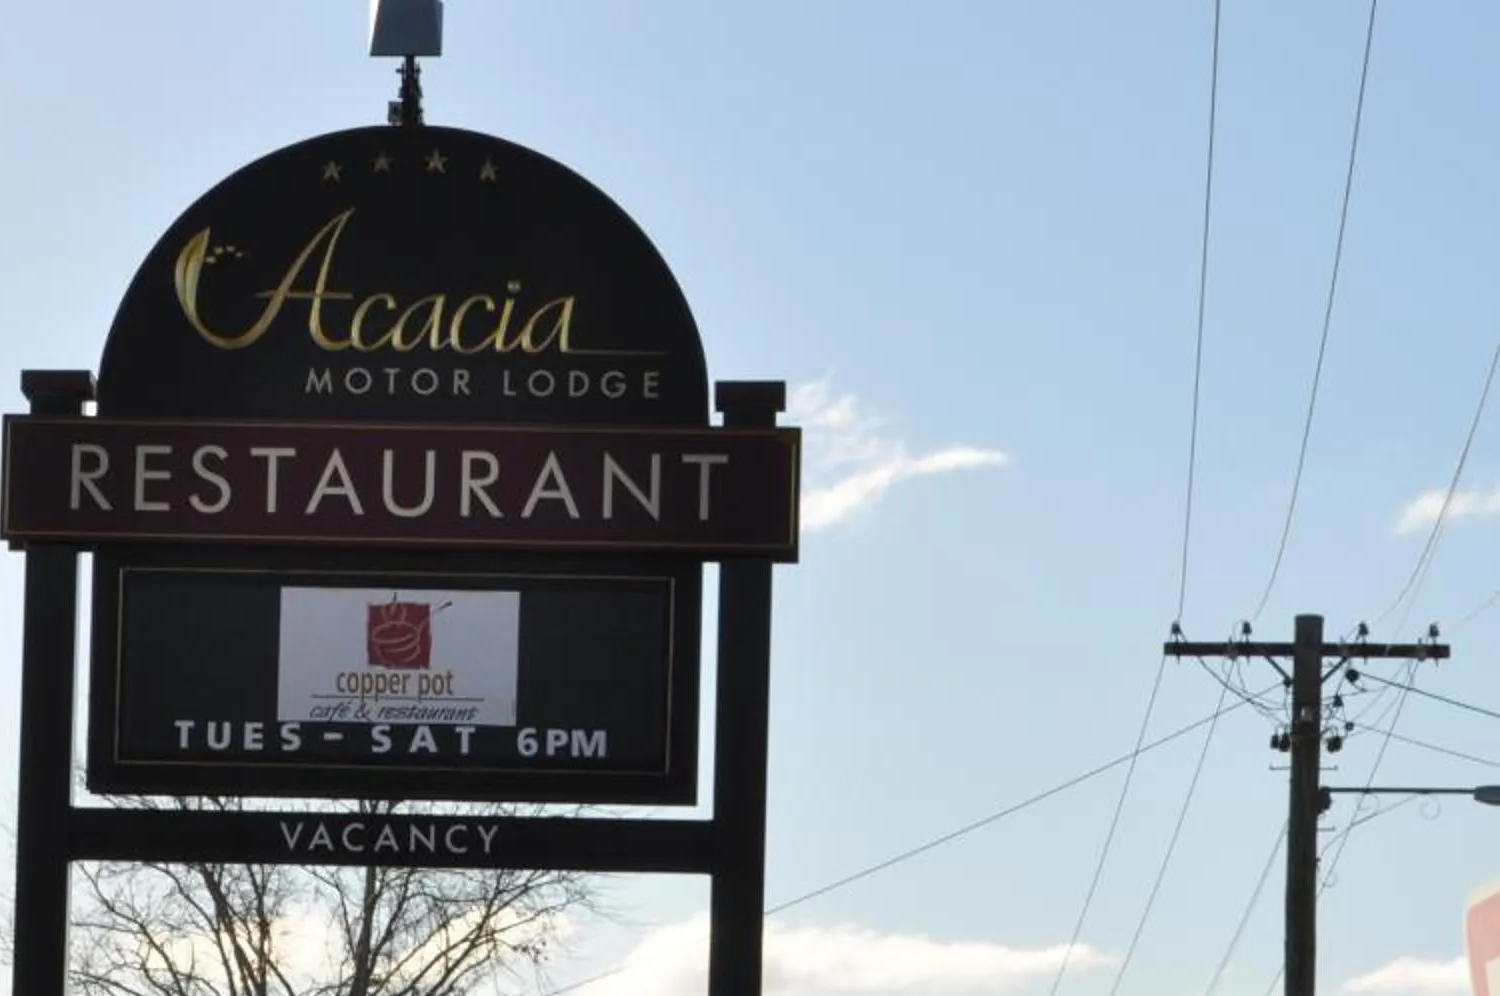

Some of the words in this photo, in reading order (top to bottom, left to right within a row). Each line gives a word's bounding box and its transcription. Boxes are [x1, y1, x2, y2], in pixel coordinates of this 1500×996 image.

[175, 205, 577, 354] Acacia
[305, 366, 472, 396] MOTOR
[503, 369, 661, 399] LODGE
[69, 442, 730, 522] RESTAURANT
[335, 672, 411, 702] copper
[418, 671, 454, 702] pot
[353, 703, 371, 719] &
[377, 703, 480, 722] restaurant
[174, 719, 302, 751] TUES
[370, 724, 478, 755] SAT
[516, 727, 608, 759] 6PM
[279, 820, 501, 854] VACANCY
